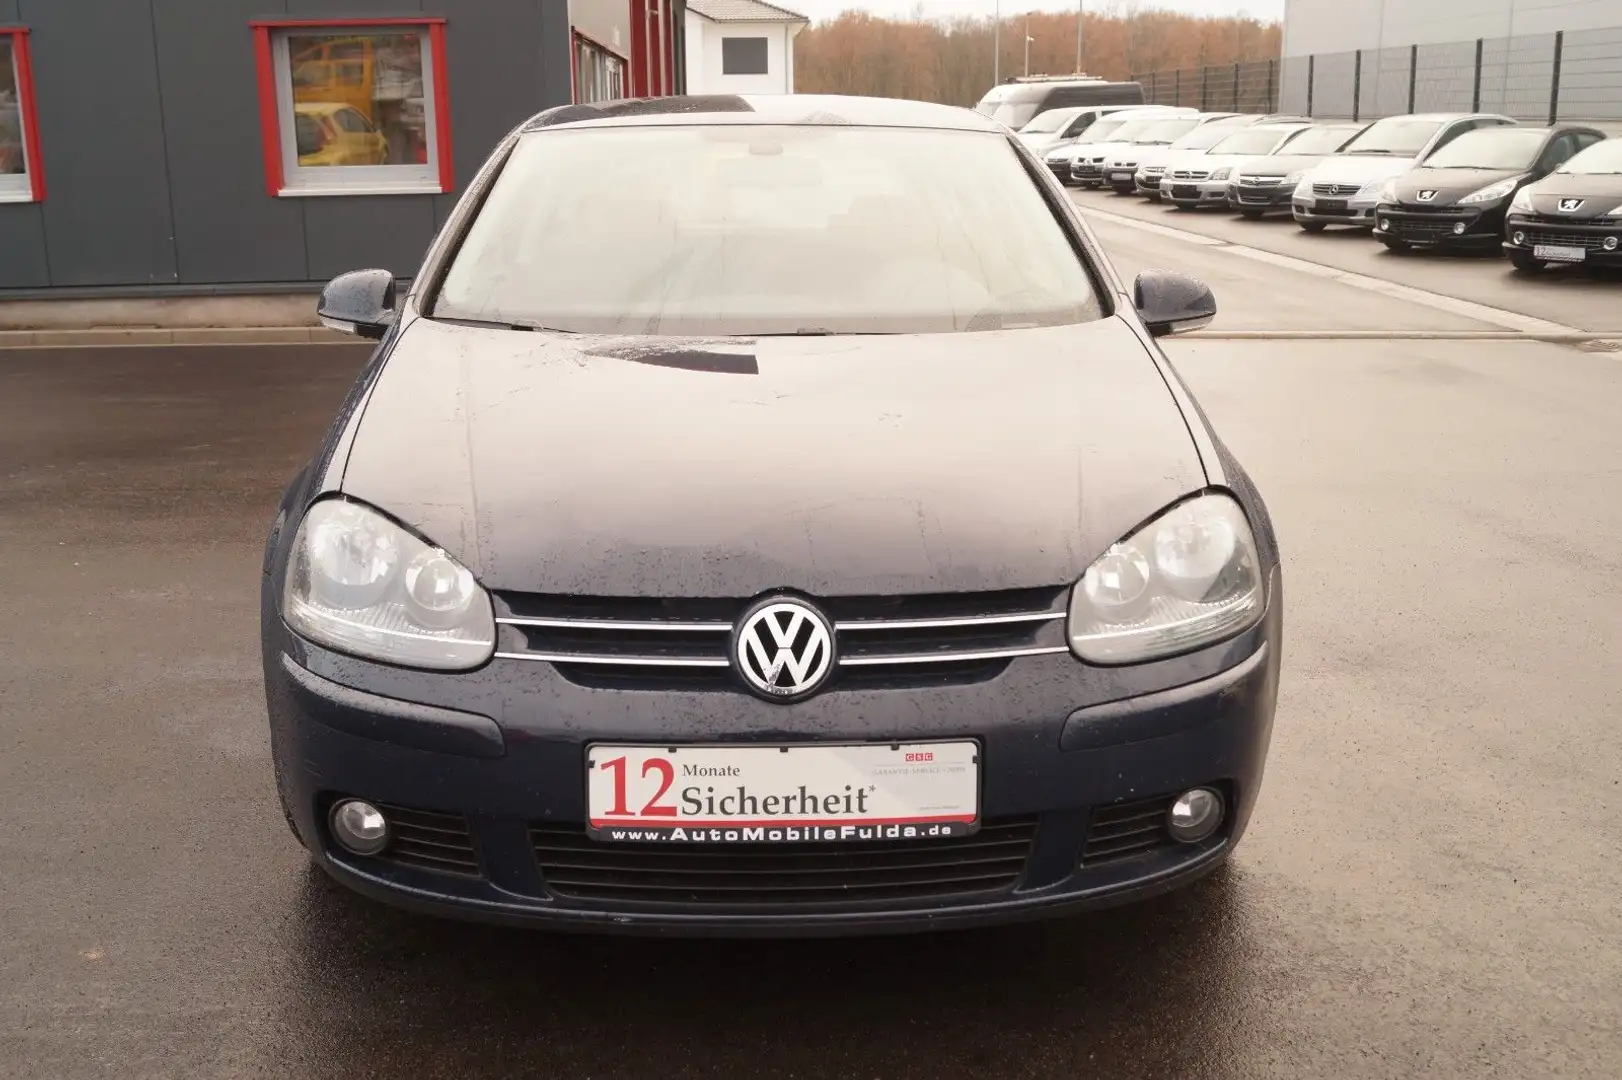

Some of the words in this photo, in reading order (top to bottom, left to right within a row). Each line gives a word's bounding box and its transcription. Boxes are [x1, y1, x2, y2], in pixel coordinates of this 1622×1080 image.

[738, 603, 831, 694] VW
[600, 756, 677, 816] 12
[682, 764, 740, 777] Monate
[611, 825, 951, 842] www.AutoMobileFulda.de
